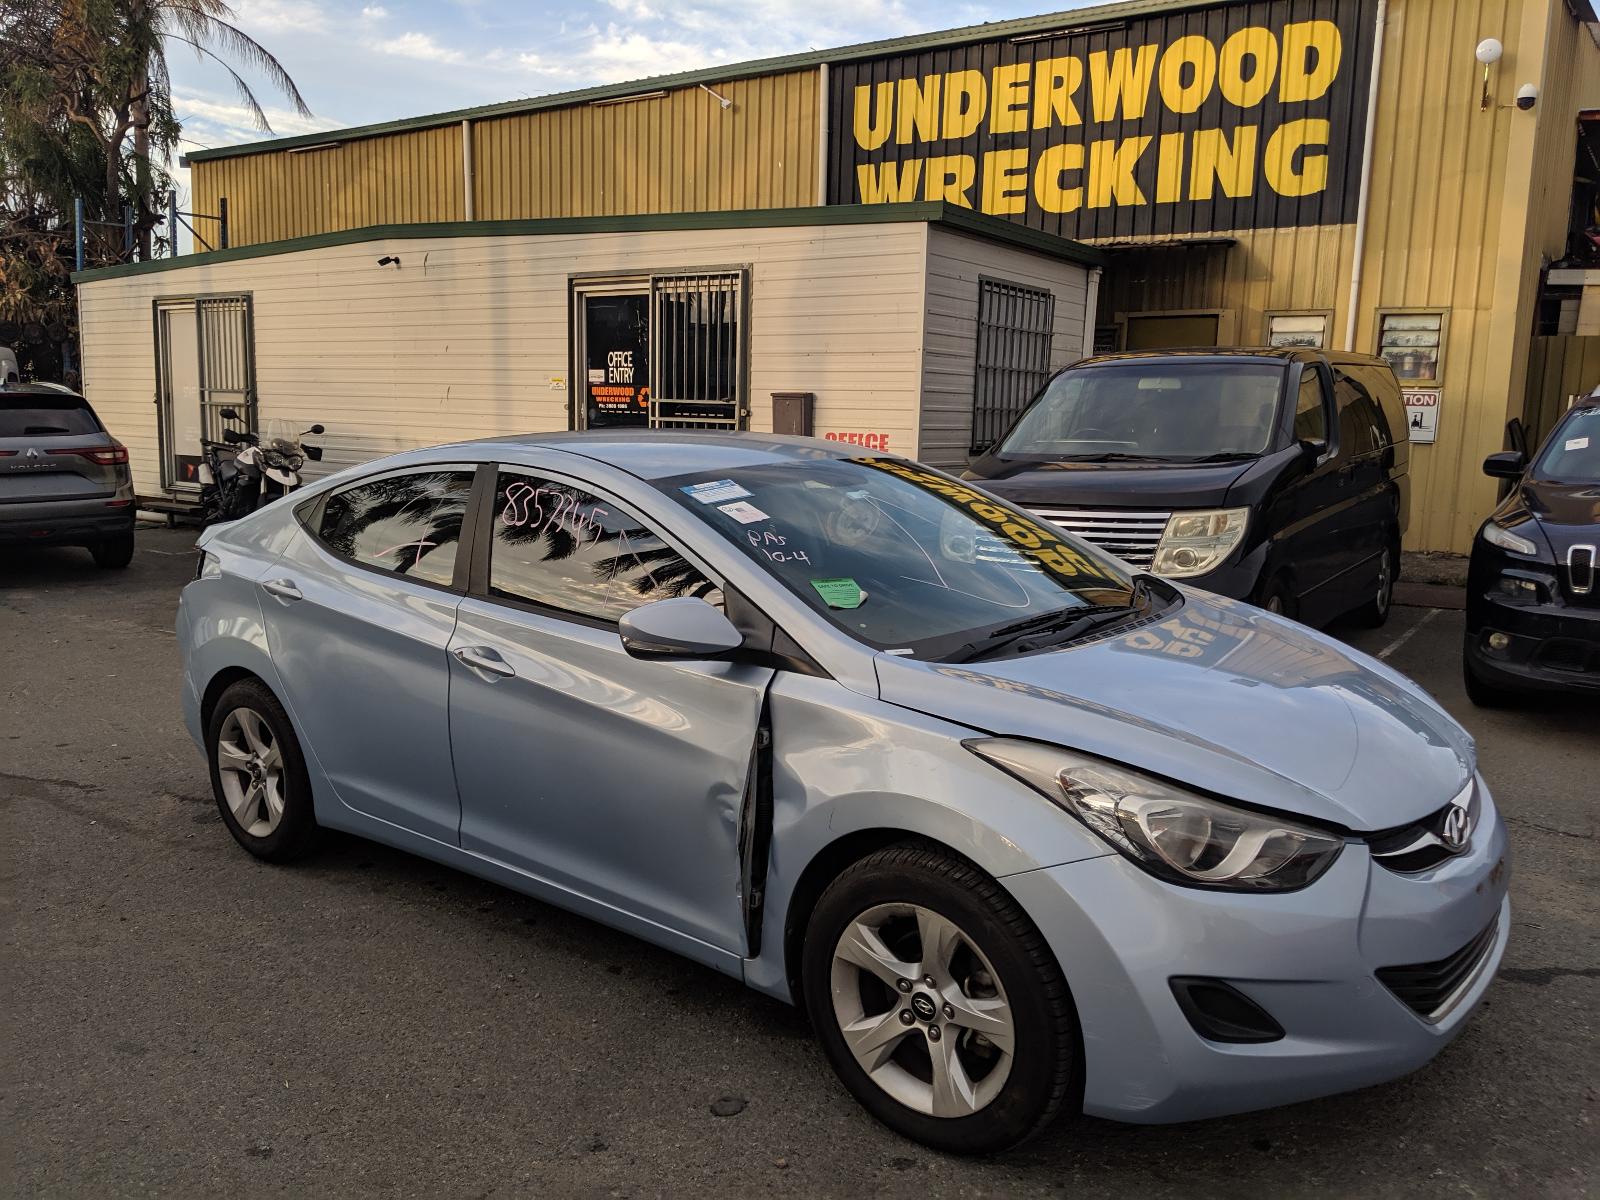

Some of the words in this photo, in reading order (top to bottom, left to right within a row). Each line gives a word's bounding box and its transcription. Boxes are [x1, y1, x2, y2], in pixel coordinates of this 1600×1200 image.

[853, 20, 1342, 151] UNDERWOOD
[856, 118, 1331, 215] WRECKING
[608, 351, 633, 367] OFFICE
[609, 368, 634, 383] ENTRY
[592, 386, 634, 396] UNDERWOOD
[1403, 395, 1435, 405] TION
[762, 549, 811, 566] 10-4
